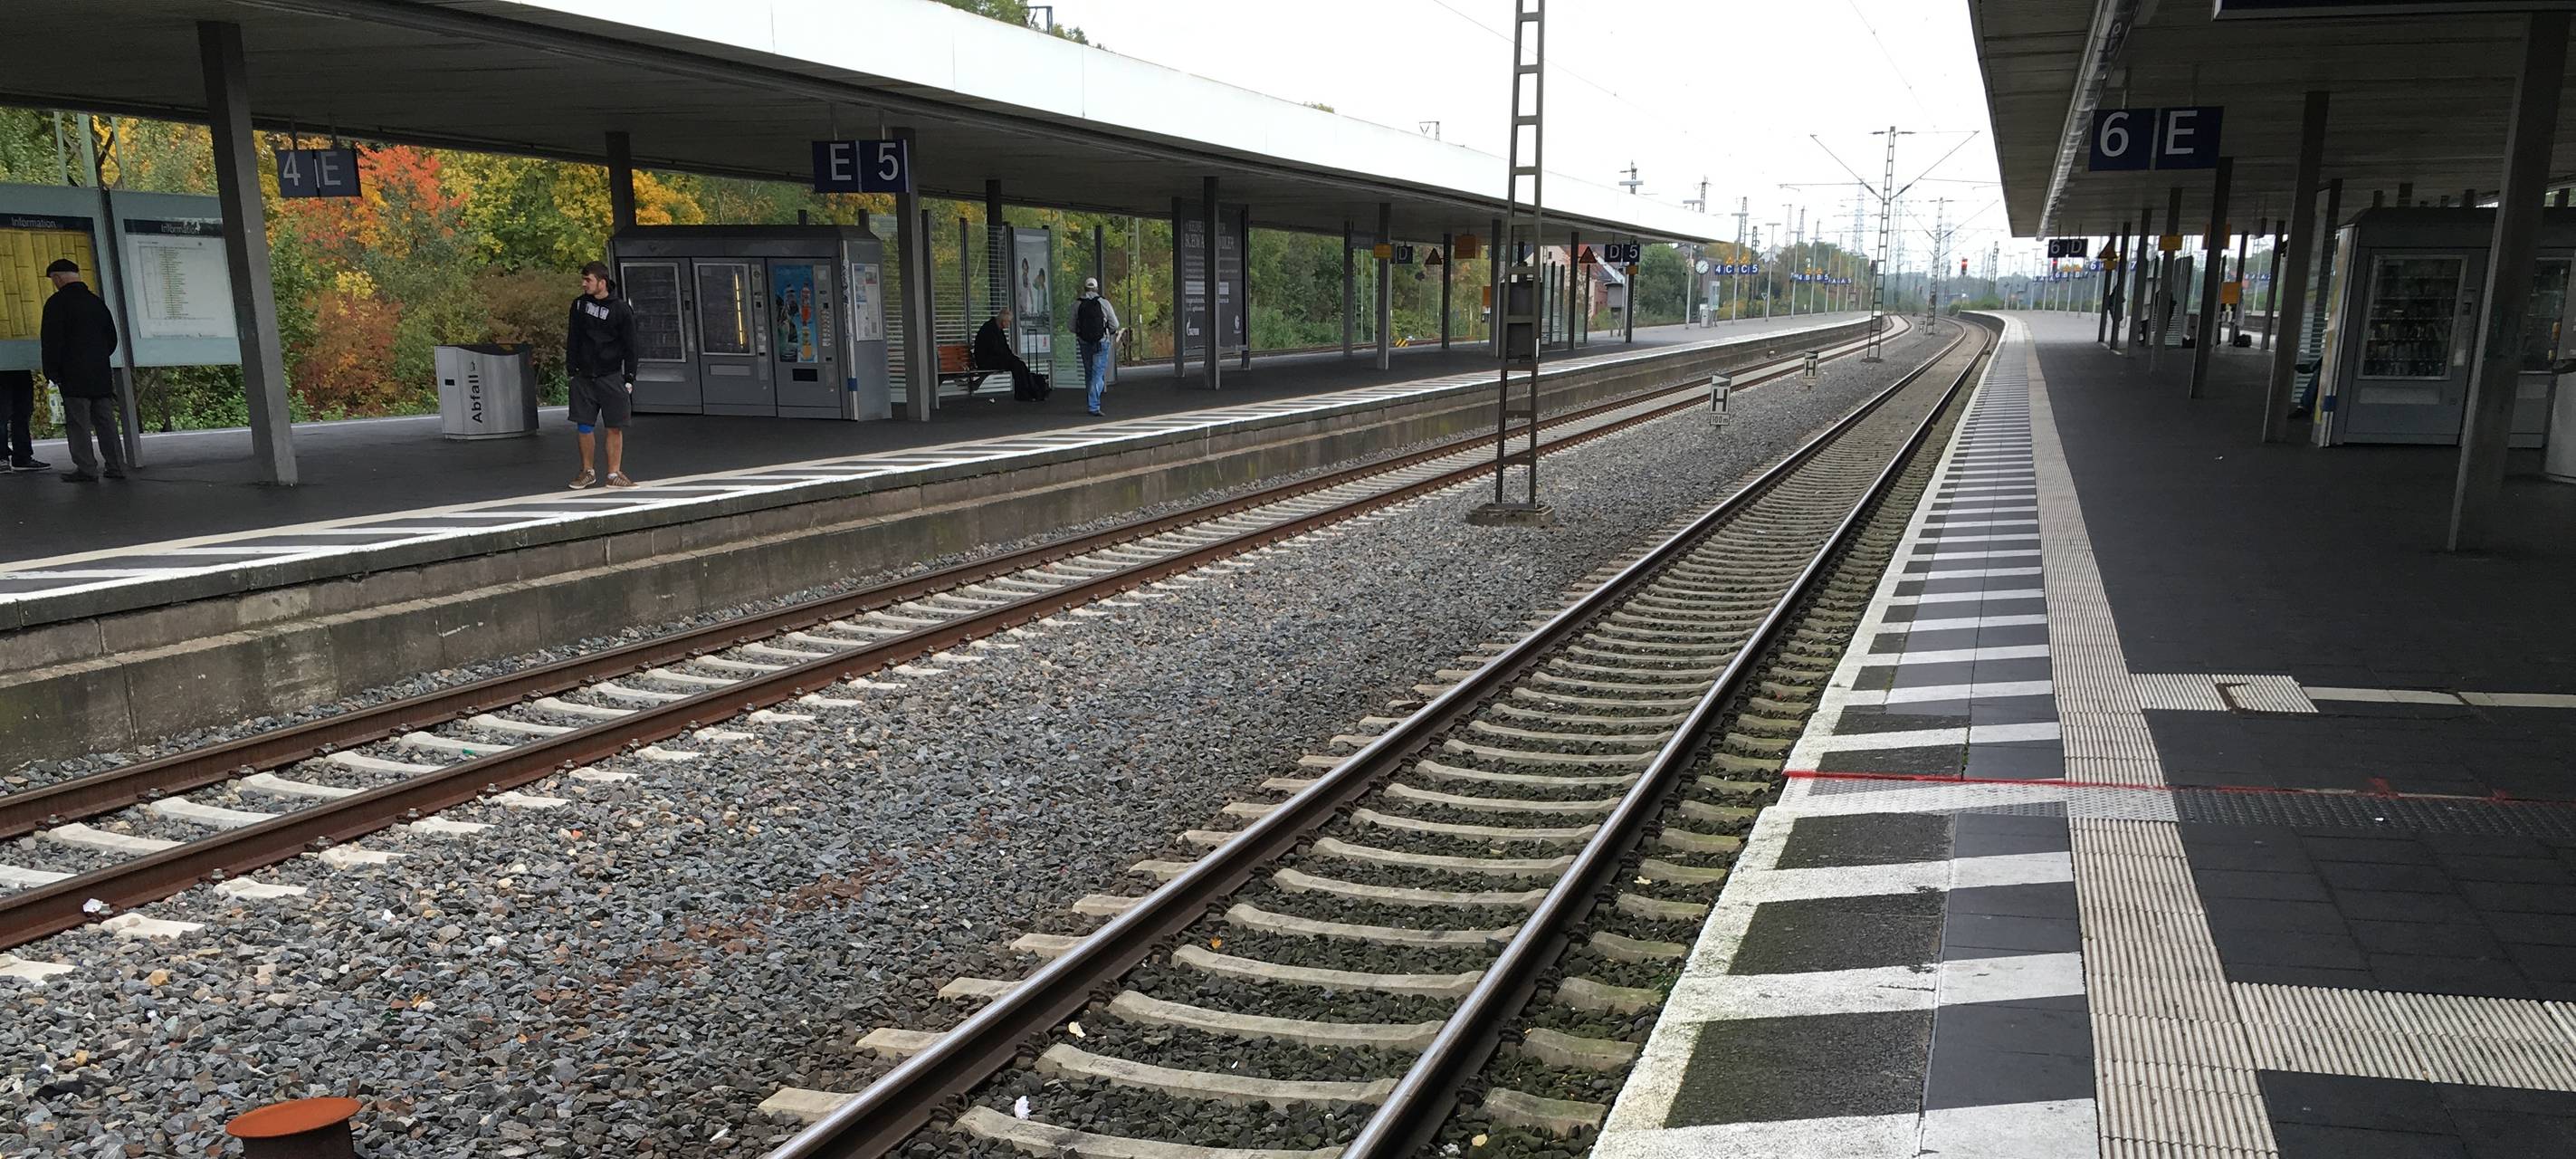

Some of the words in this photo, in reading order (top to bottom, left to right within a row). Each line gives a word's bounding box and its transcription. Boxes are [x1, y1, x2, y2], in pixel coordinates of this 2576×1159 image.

[2100, 111, 2129, 157] 6
[2164, 110, 2198, 155] E
[282, 151, 301, 187] 4
[320, 151, 341, 186] E
[829, 143, 852, 181] E
[878, 142, 899, 181] 5
[12, 216, 57, 229] Information
[1398, 246, 1408, 261] D
[1610, 244, 1620, 259] D
[1629, 244, 1638, 259] 5
[2050, 240, 2061, 254] 6
[2071, 239, 2083, 254] D
[1715, 264, 1722, 273] 4
[1726, 264, 1732, 273] C
[1741, 264, 1748, 273] C
[1752, 263, 1759, 273] 5
[2090, 261, 2096, 270] 6
[1805, 360, 1816, 377] H
[468, 374, 483, 424] Abfall
[1712, 388, 1728, 412] H
[1712, 416, 1723, 424] 100
